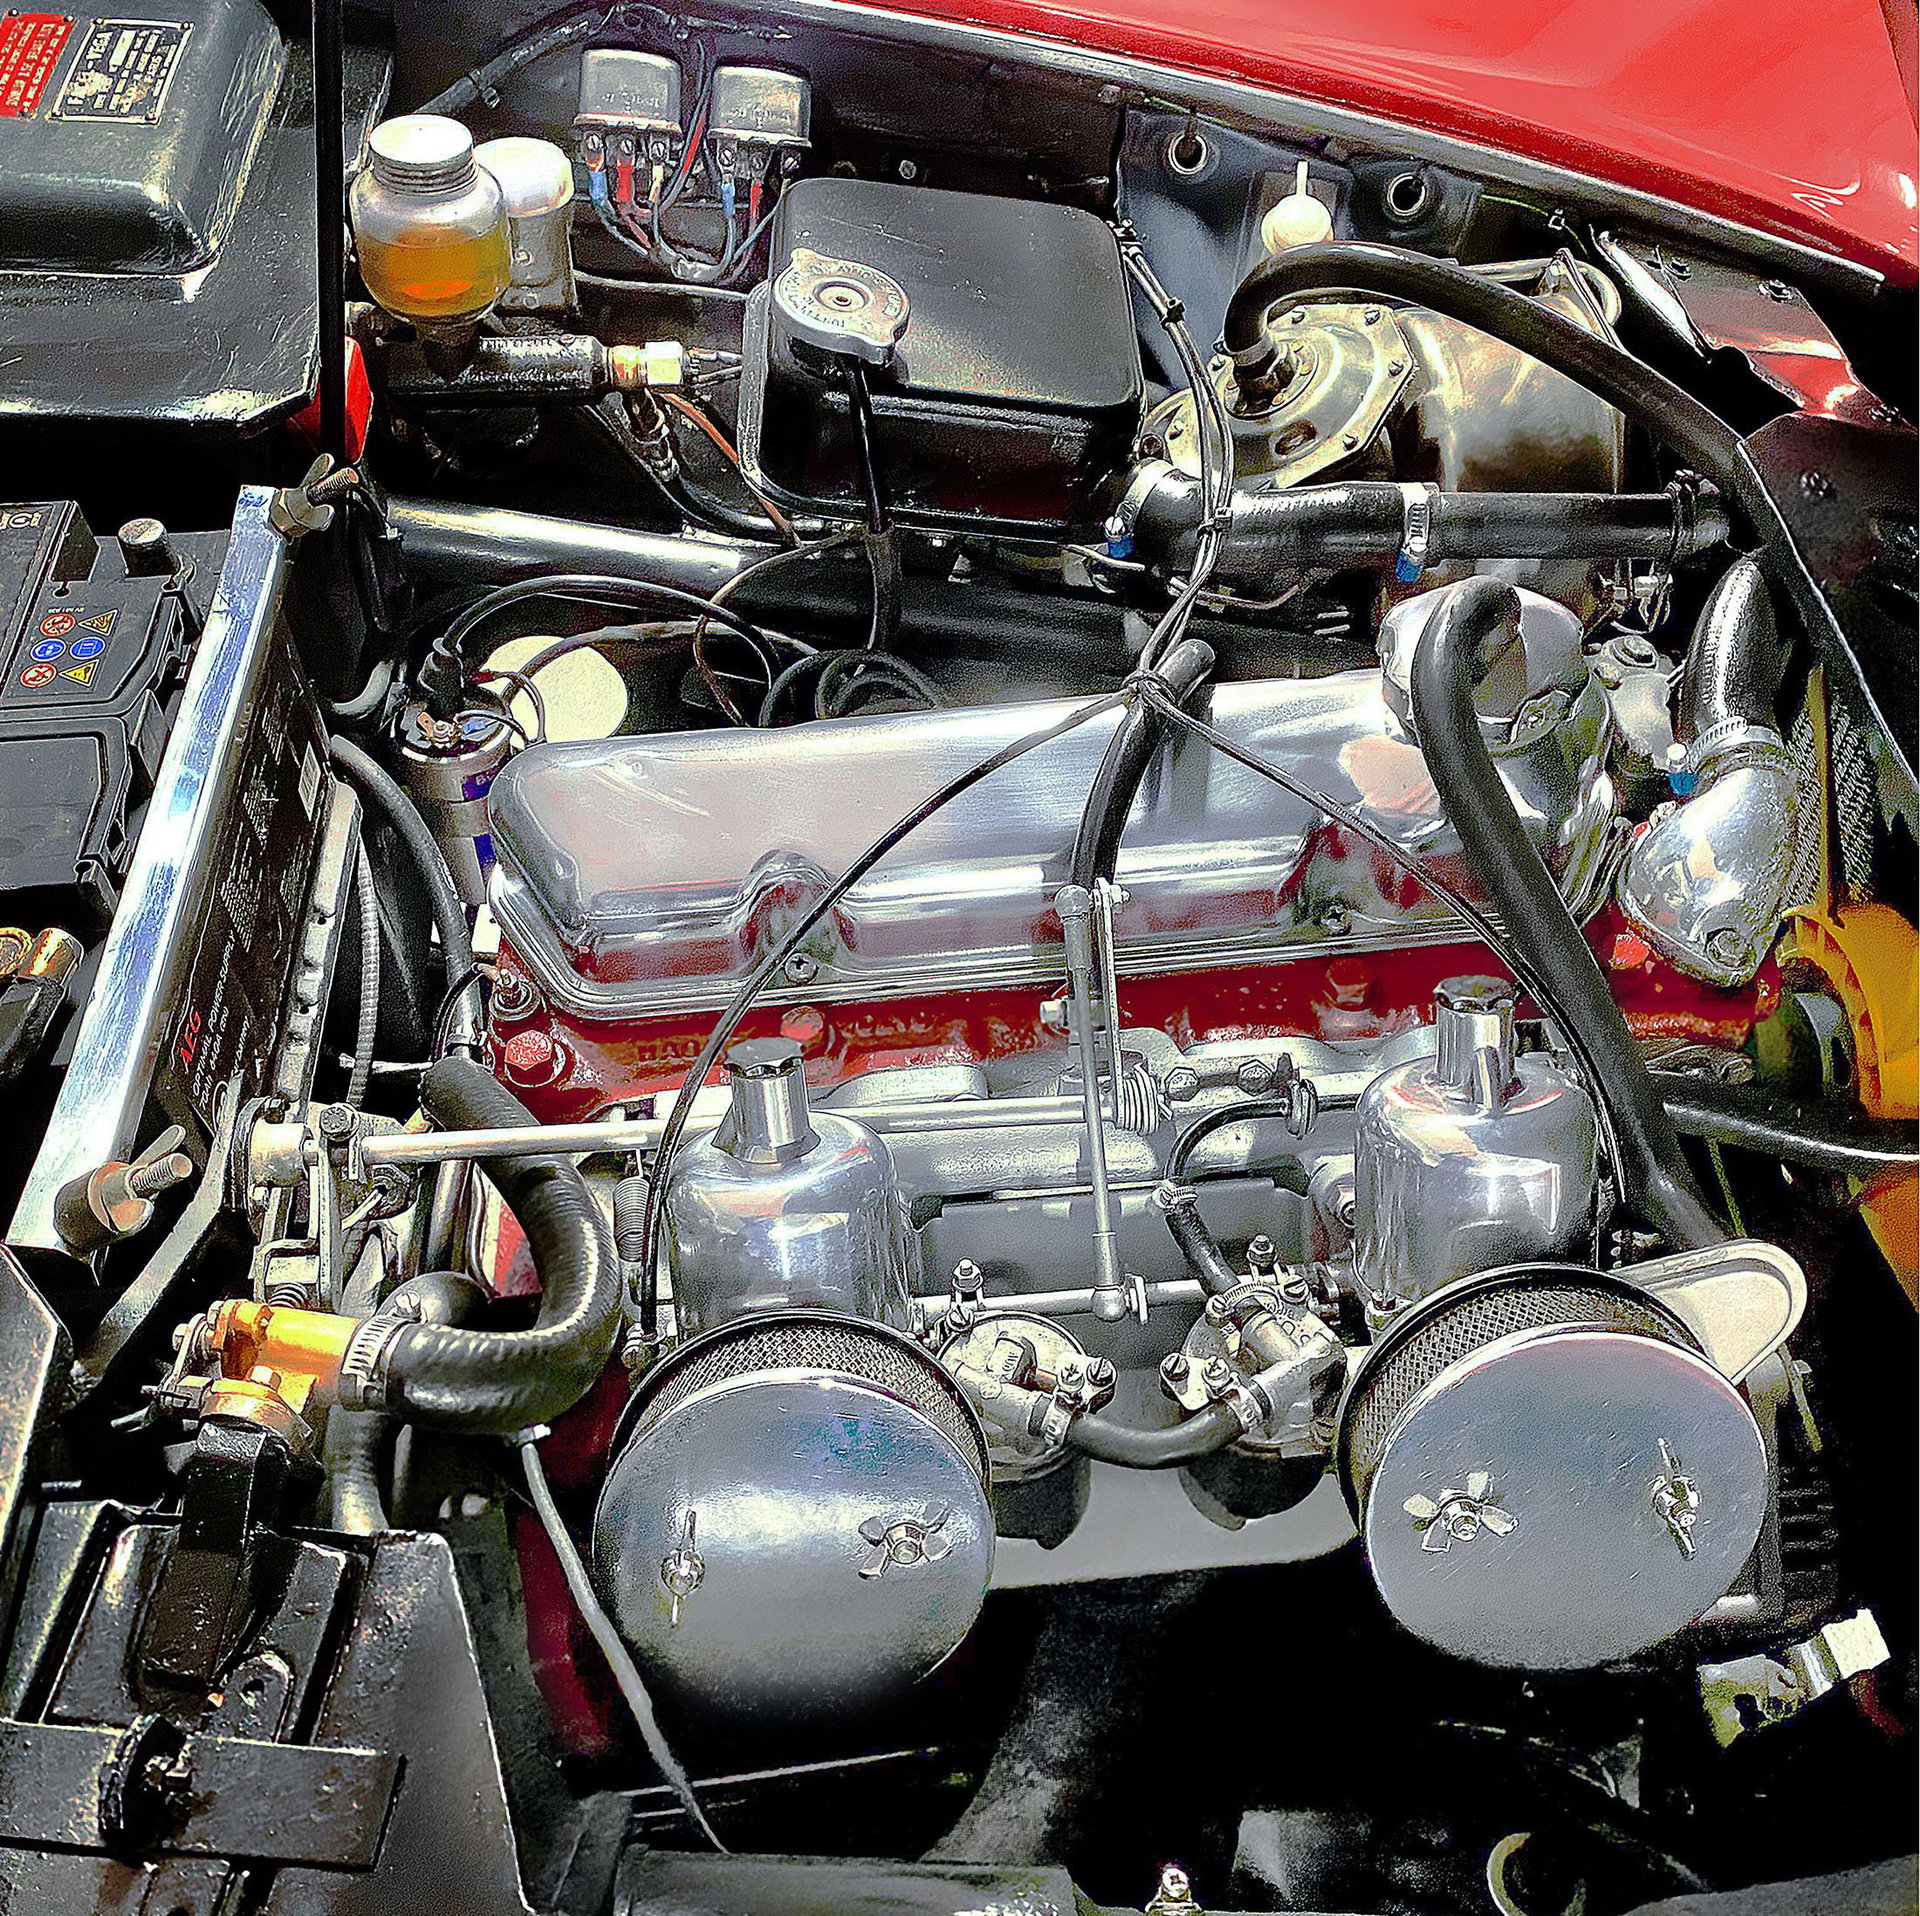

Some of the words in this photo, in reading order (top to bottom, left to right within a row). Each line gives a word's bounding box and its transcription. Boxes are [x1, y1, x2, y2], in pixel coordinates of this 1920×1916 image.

[180, 1005, 201, 1075] AEG
[192, 1034, 213, 1098] OPTIMAL
[208, 981, 225, 1033] POWER
[219, 929, 237, 983] SUPPLY
